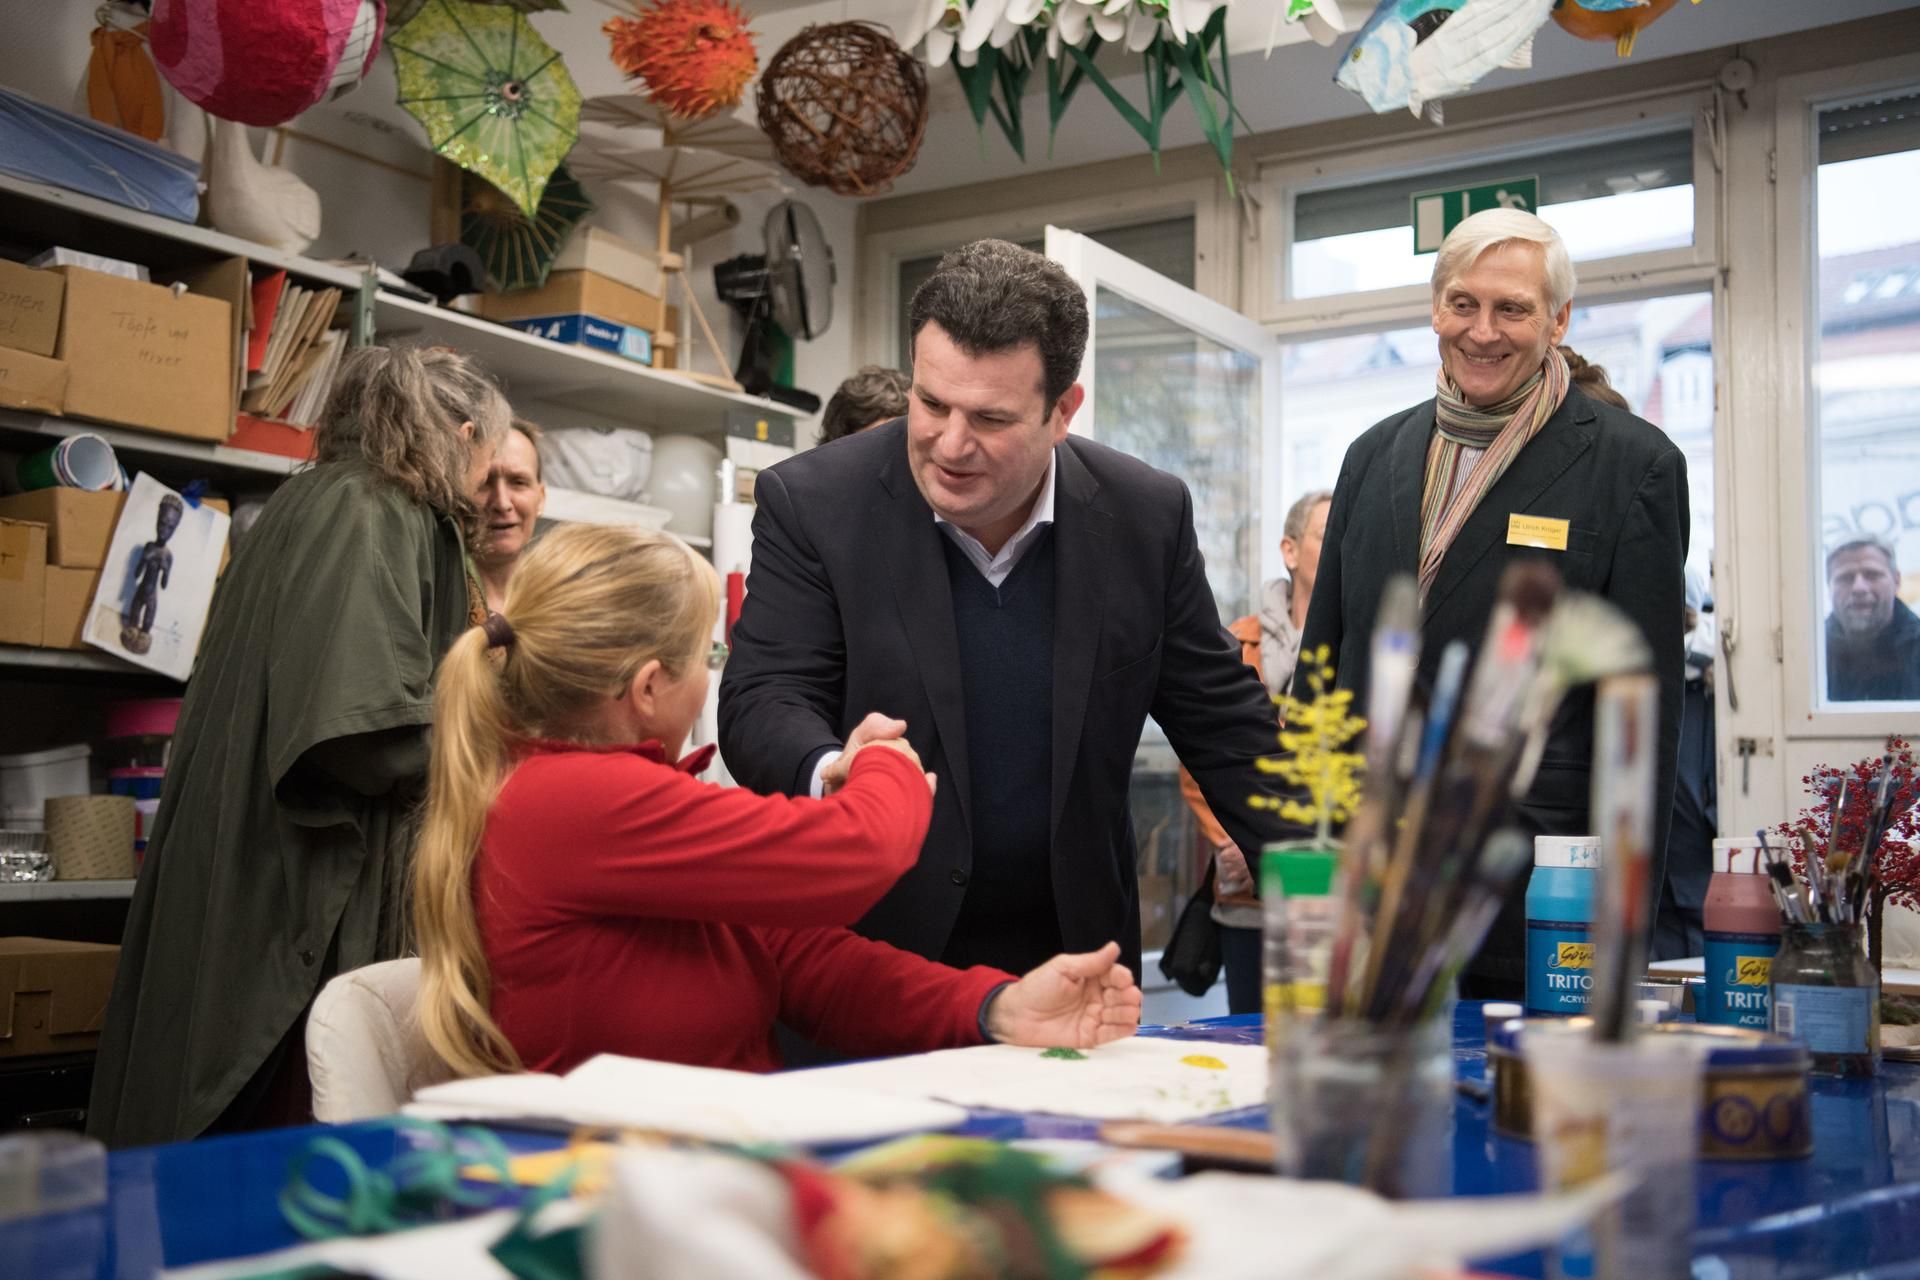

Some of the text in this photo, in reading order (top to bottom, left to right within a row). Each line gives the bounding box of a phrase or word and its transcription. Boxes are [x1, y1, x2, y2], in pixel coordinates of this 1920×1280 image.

[1546, 973, 1594, 990] TRITO
[1725, 960, 1769, 989] Goy
[1724, 990, 1769, 1009] TRIT
[1738, 1015, 1766, 1025] ACRY
